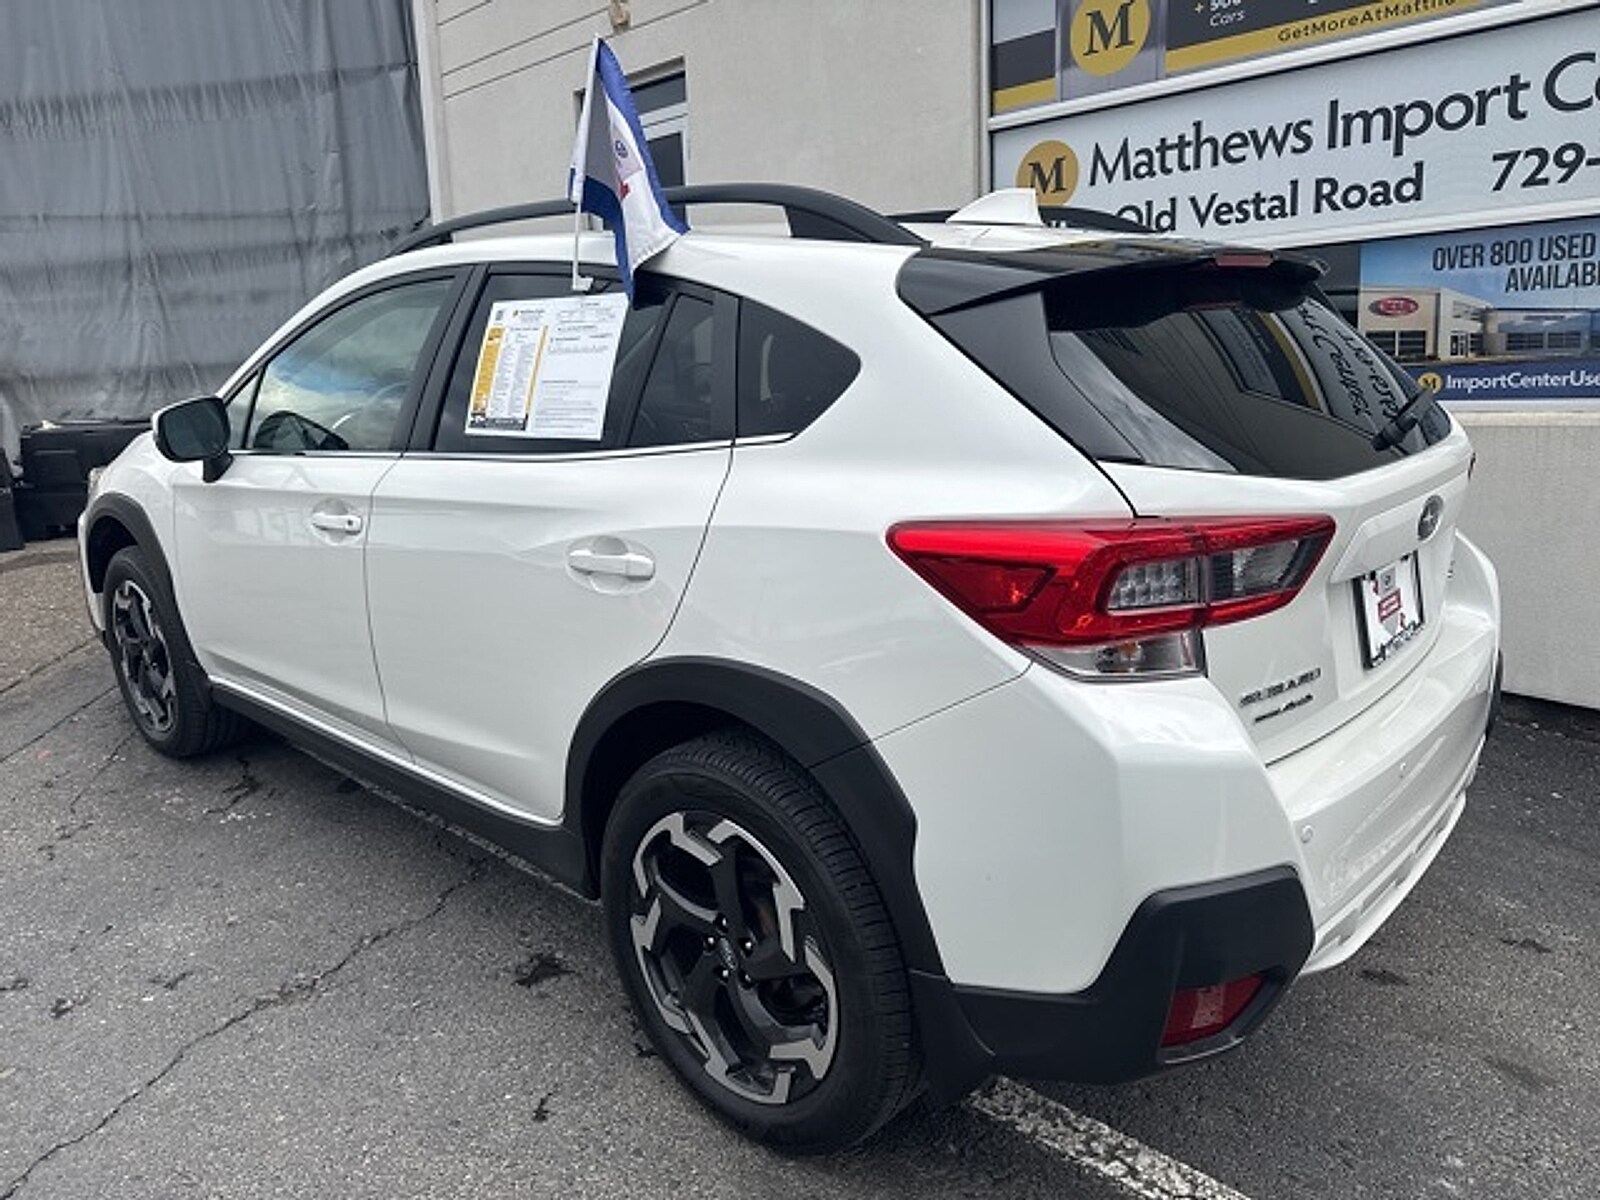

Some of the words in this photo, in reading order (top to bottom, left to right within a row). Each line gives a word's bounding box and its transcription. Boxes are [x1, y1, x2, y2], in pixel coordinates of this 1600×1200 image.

[1083, 0, 1136, 56] M
[1089, 119, 1314, 187] Matthews
[1328, 73, 1531, 157] Import
[1543, 52, 1600, 112] C
[1028, 155, 1067, 194] M
[1189, 179, 1299, 228] Vestal
[1313, 161, 1424, 214] Road
[1432, 242, 1484, 271] OVER
[1490, 237, 1533, 266] 800
[1538, 232, 1596, 261] USED
[1505, 261, 1600, 293] AVAILAB
